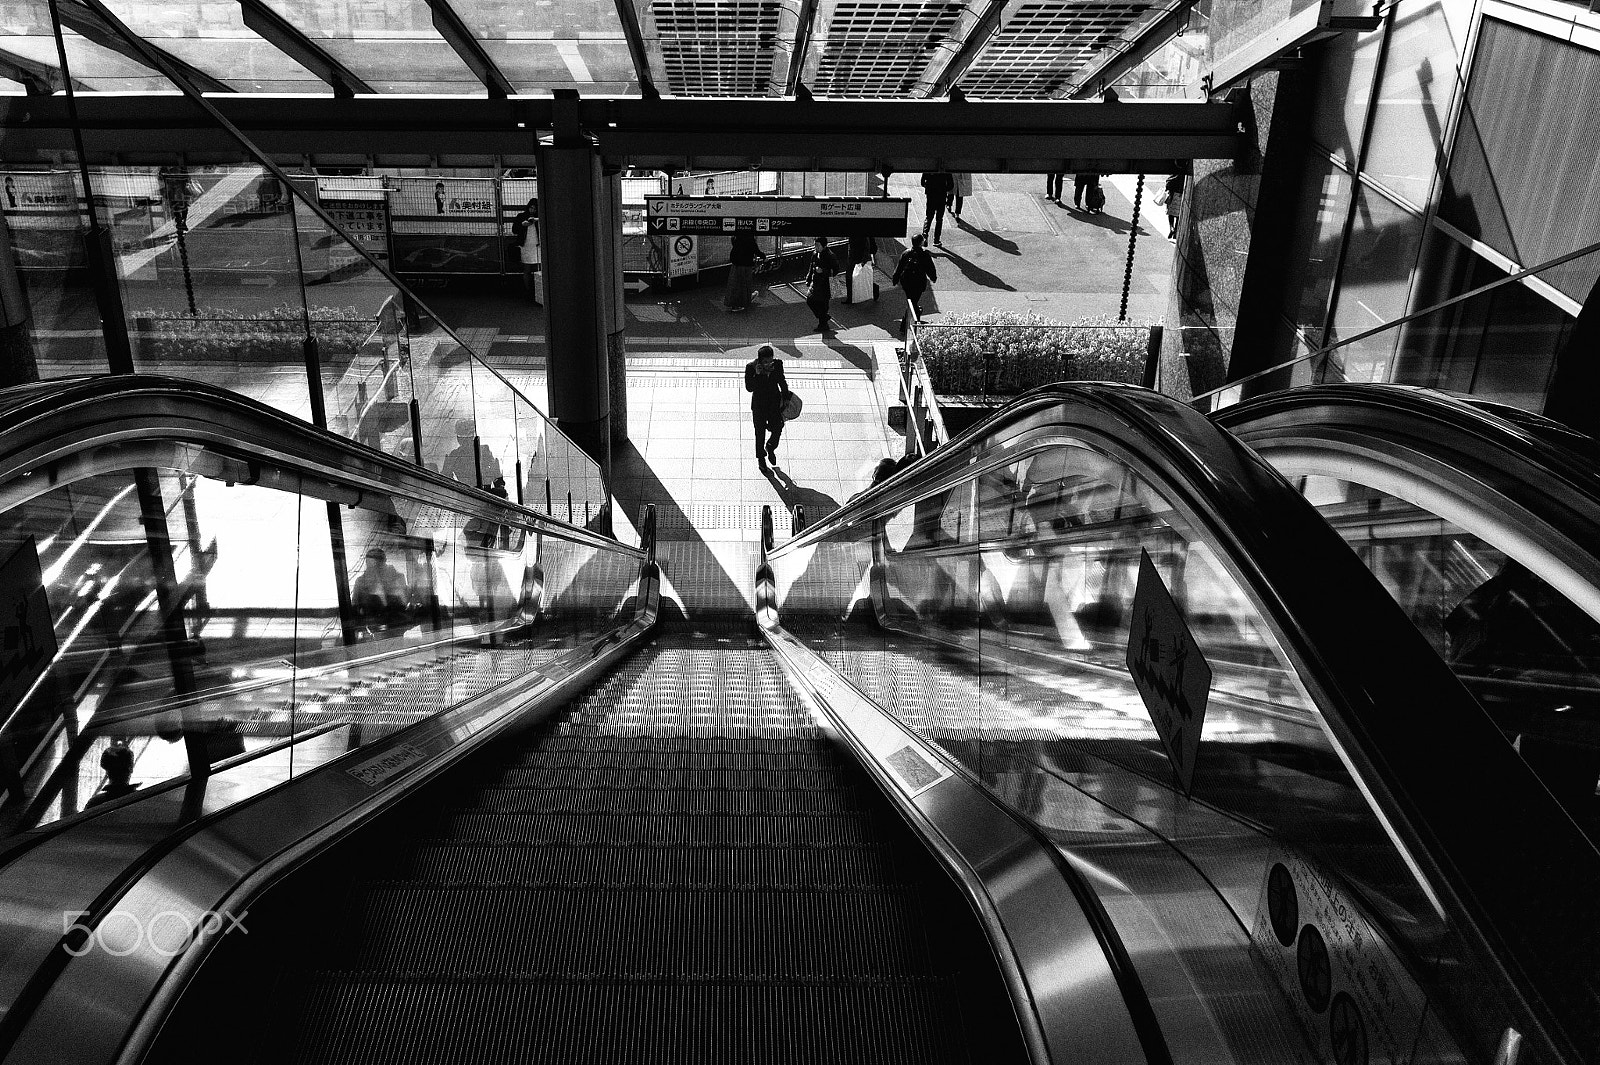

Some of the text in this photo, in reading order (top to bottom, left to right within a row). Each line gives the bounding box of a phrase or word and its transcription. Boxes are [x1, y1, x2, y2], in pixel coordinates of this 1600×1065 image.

[462, 201, 491, 210] 奥村組
[820, 203, 862, 211] 南ゲート広場
